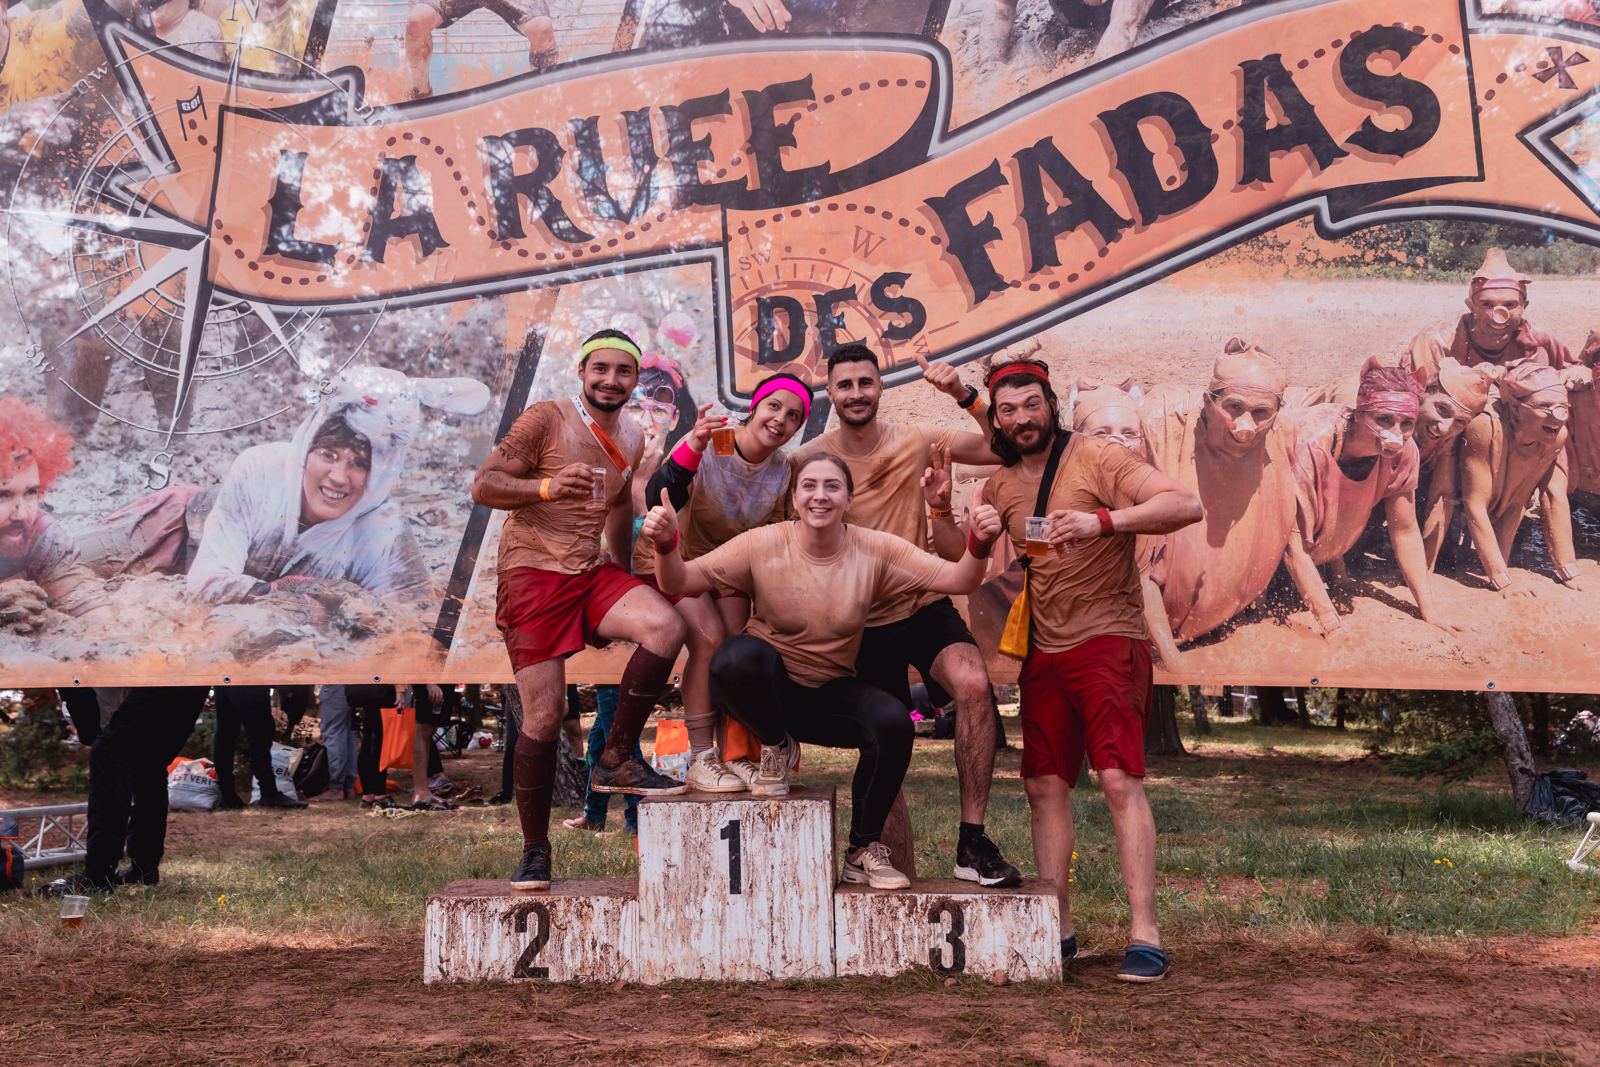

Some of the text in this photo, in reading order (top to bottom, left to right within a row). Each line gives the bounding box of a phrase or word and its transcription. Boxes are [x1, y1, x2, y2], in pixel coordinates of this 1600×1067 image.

[262, 149, 450, 266] LA
[755, 23, 1442, 365] DES FADAS
[738, 248, 772, 271] SW
[852, 225, 887, 259] W
[144, 451, 173, 490] S
[719, 819, 742, 895] 1
[513, 903, 550, 979] 2
[927, 900, 966, 973] 3
